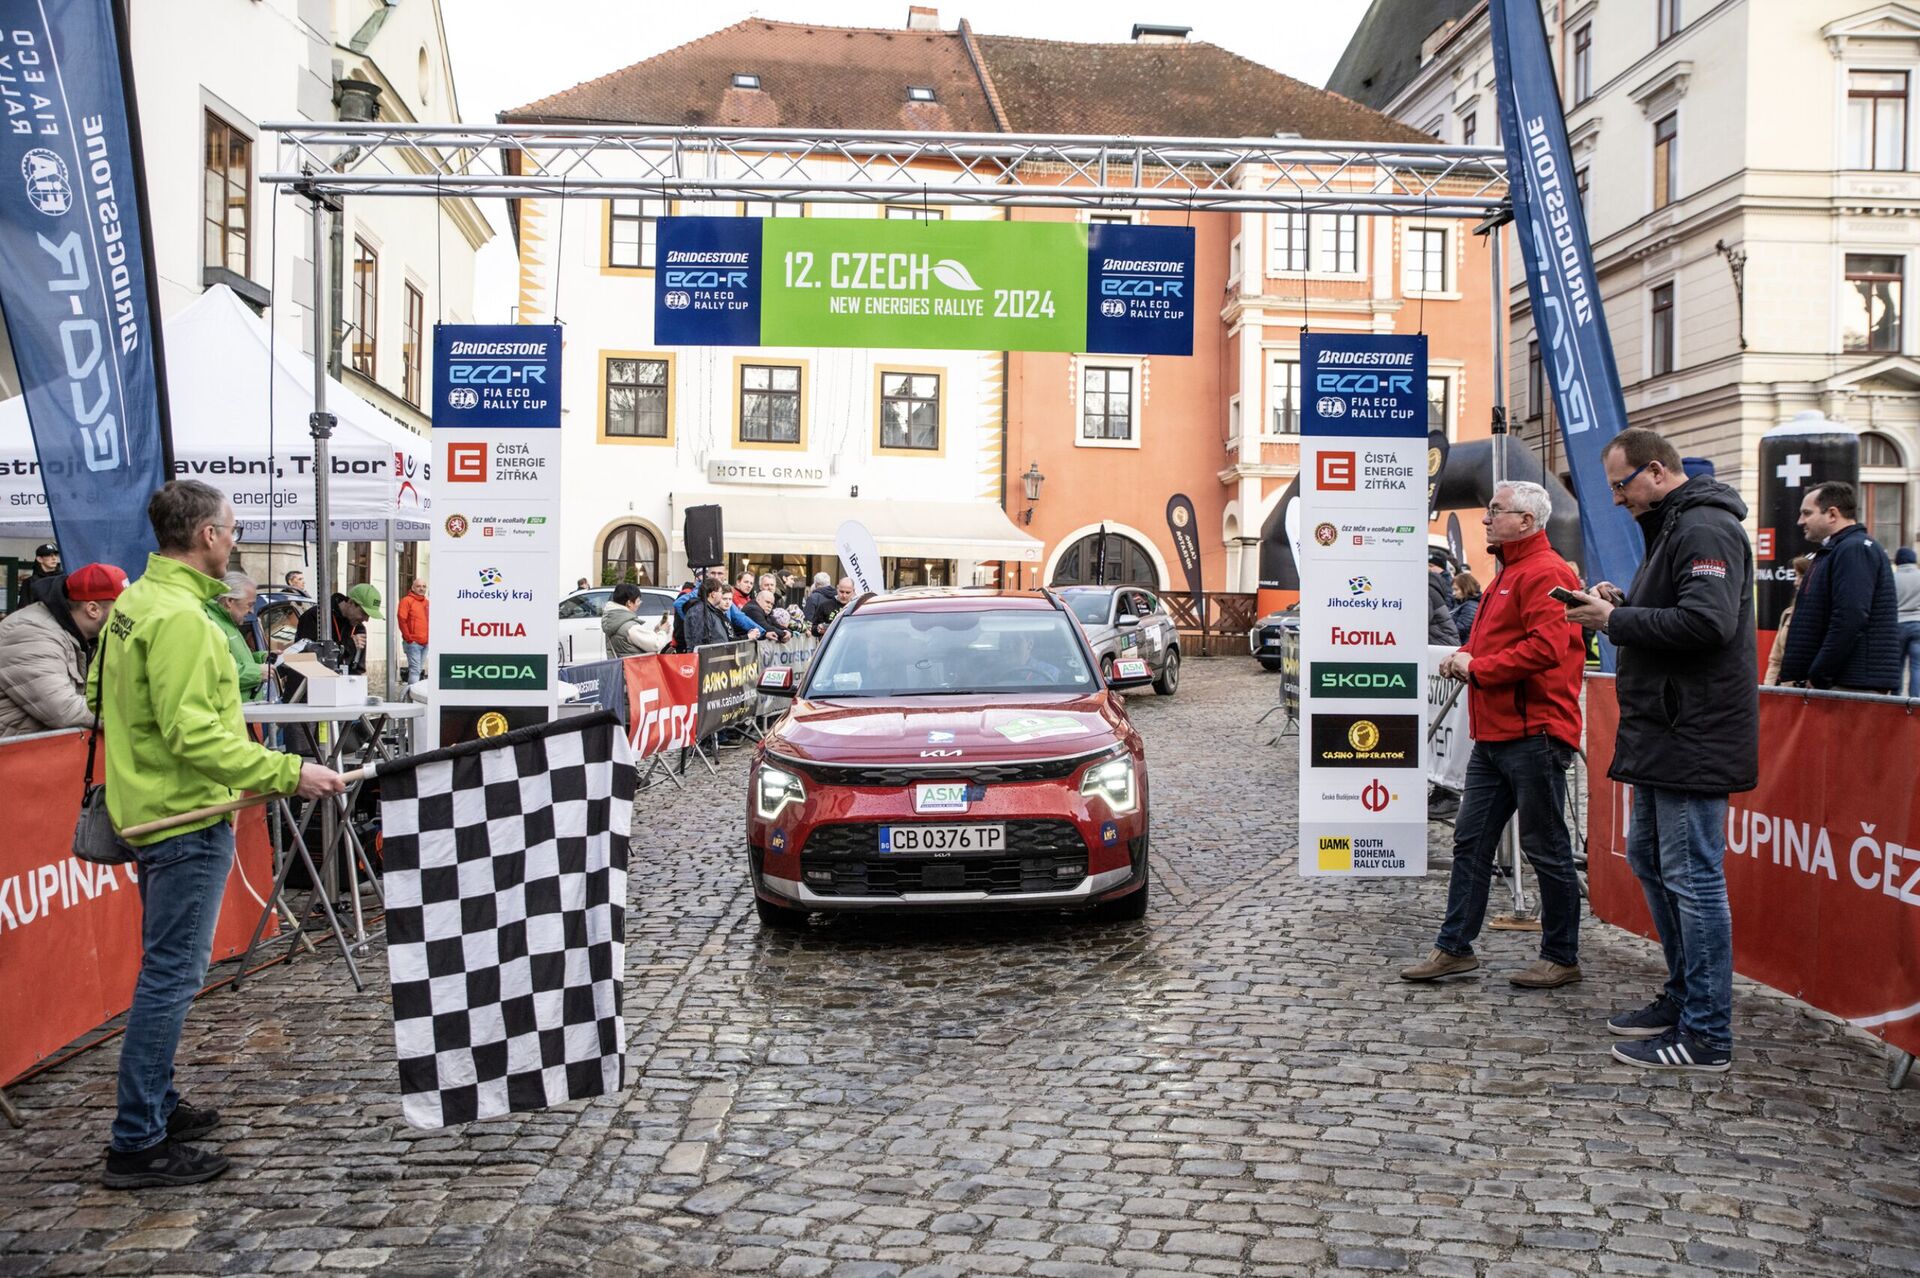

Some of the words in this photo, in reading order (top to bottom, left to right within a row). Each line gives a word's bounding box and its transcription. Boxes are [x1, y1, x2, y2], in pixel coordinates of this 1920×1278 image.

[666, 250, 749, 263] BRIDGESTONE
[784, 251, 822, 289] 12.
[831, 252, 929, 291] CZECH
[1101, 259, 1184, 273] BRIDGESTONE
[695, 291, 711, 300] FIA
[714, 291, 734, 300] ECO
[695, 301, 724, 310] RALLY
[728, 301, 749, 310] CUP
[830, 296, 860, 313] NEW
[865, 297, 929, 315] ENERGIES
[934, 298, 984, 316] RALLYE
[994, 289, 1055, 318] 2024
[1131, 300, 1147, 309] FIA
[1150, 301, 1170, 309] ECO
[1131, 309, 1160, 318] RALLY
[1164, 311, 1184, 320] CUP
[450, 341, 548, 355] BRIDGESTONE
[1317, 350, 1414, 365] BRIDGESTONE
[484, 388, 502, 398] FIA
[507, 388, 530, 398] ECO
[484, 400, 518, 409] RALLY
[523, 400, 548, 409] CUP
[1351, 397, 1370, 407] FIA
[1374, 398, 1397, 407] ECO
[1351, 409, 1386, 418] RALLY
[1391, 410, 1414, 419] CUP
[496, 442, 530, 455] ČISTÁ
[1364, 451, 1397, 463] ČISTÁ
[496, 458, 546, 467] ENERGIE
[496, 471, 538, 480] ZÍTŘKA
[717, 465, 766, 477] HOTEL
[773, 467, 823, 480] GRAND
[1364, 467, 1413, 477] ENERGIE
[1364, 480, 1406, 490] ZÍTŘKA
[457, 590, 509, 602] Jihočeský
[512, 590, 533, 602] kraj
[1327, 598, 1378, 610] Jihočeský
[1382, 598, 1402, 610] kraj
[1122, 663, 1143, 673] ASM
[766, 672, 785, 681] ASM
[1322, 751, 1354, 759] CASINO
[923, 788, 963, 803] ASM
[893, 830, 918, 848] CB
[923, 829, 971, 848] 0376
[975, 828, 1000, 847] TP
[1354, 839, 1383, 848] SOUTH
[1354, 850, 1395, 858] BOHEMIA
[1354, 859, 1379, 868] RALLY
[1382, 860, 1405, 868] CLUB
